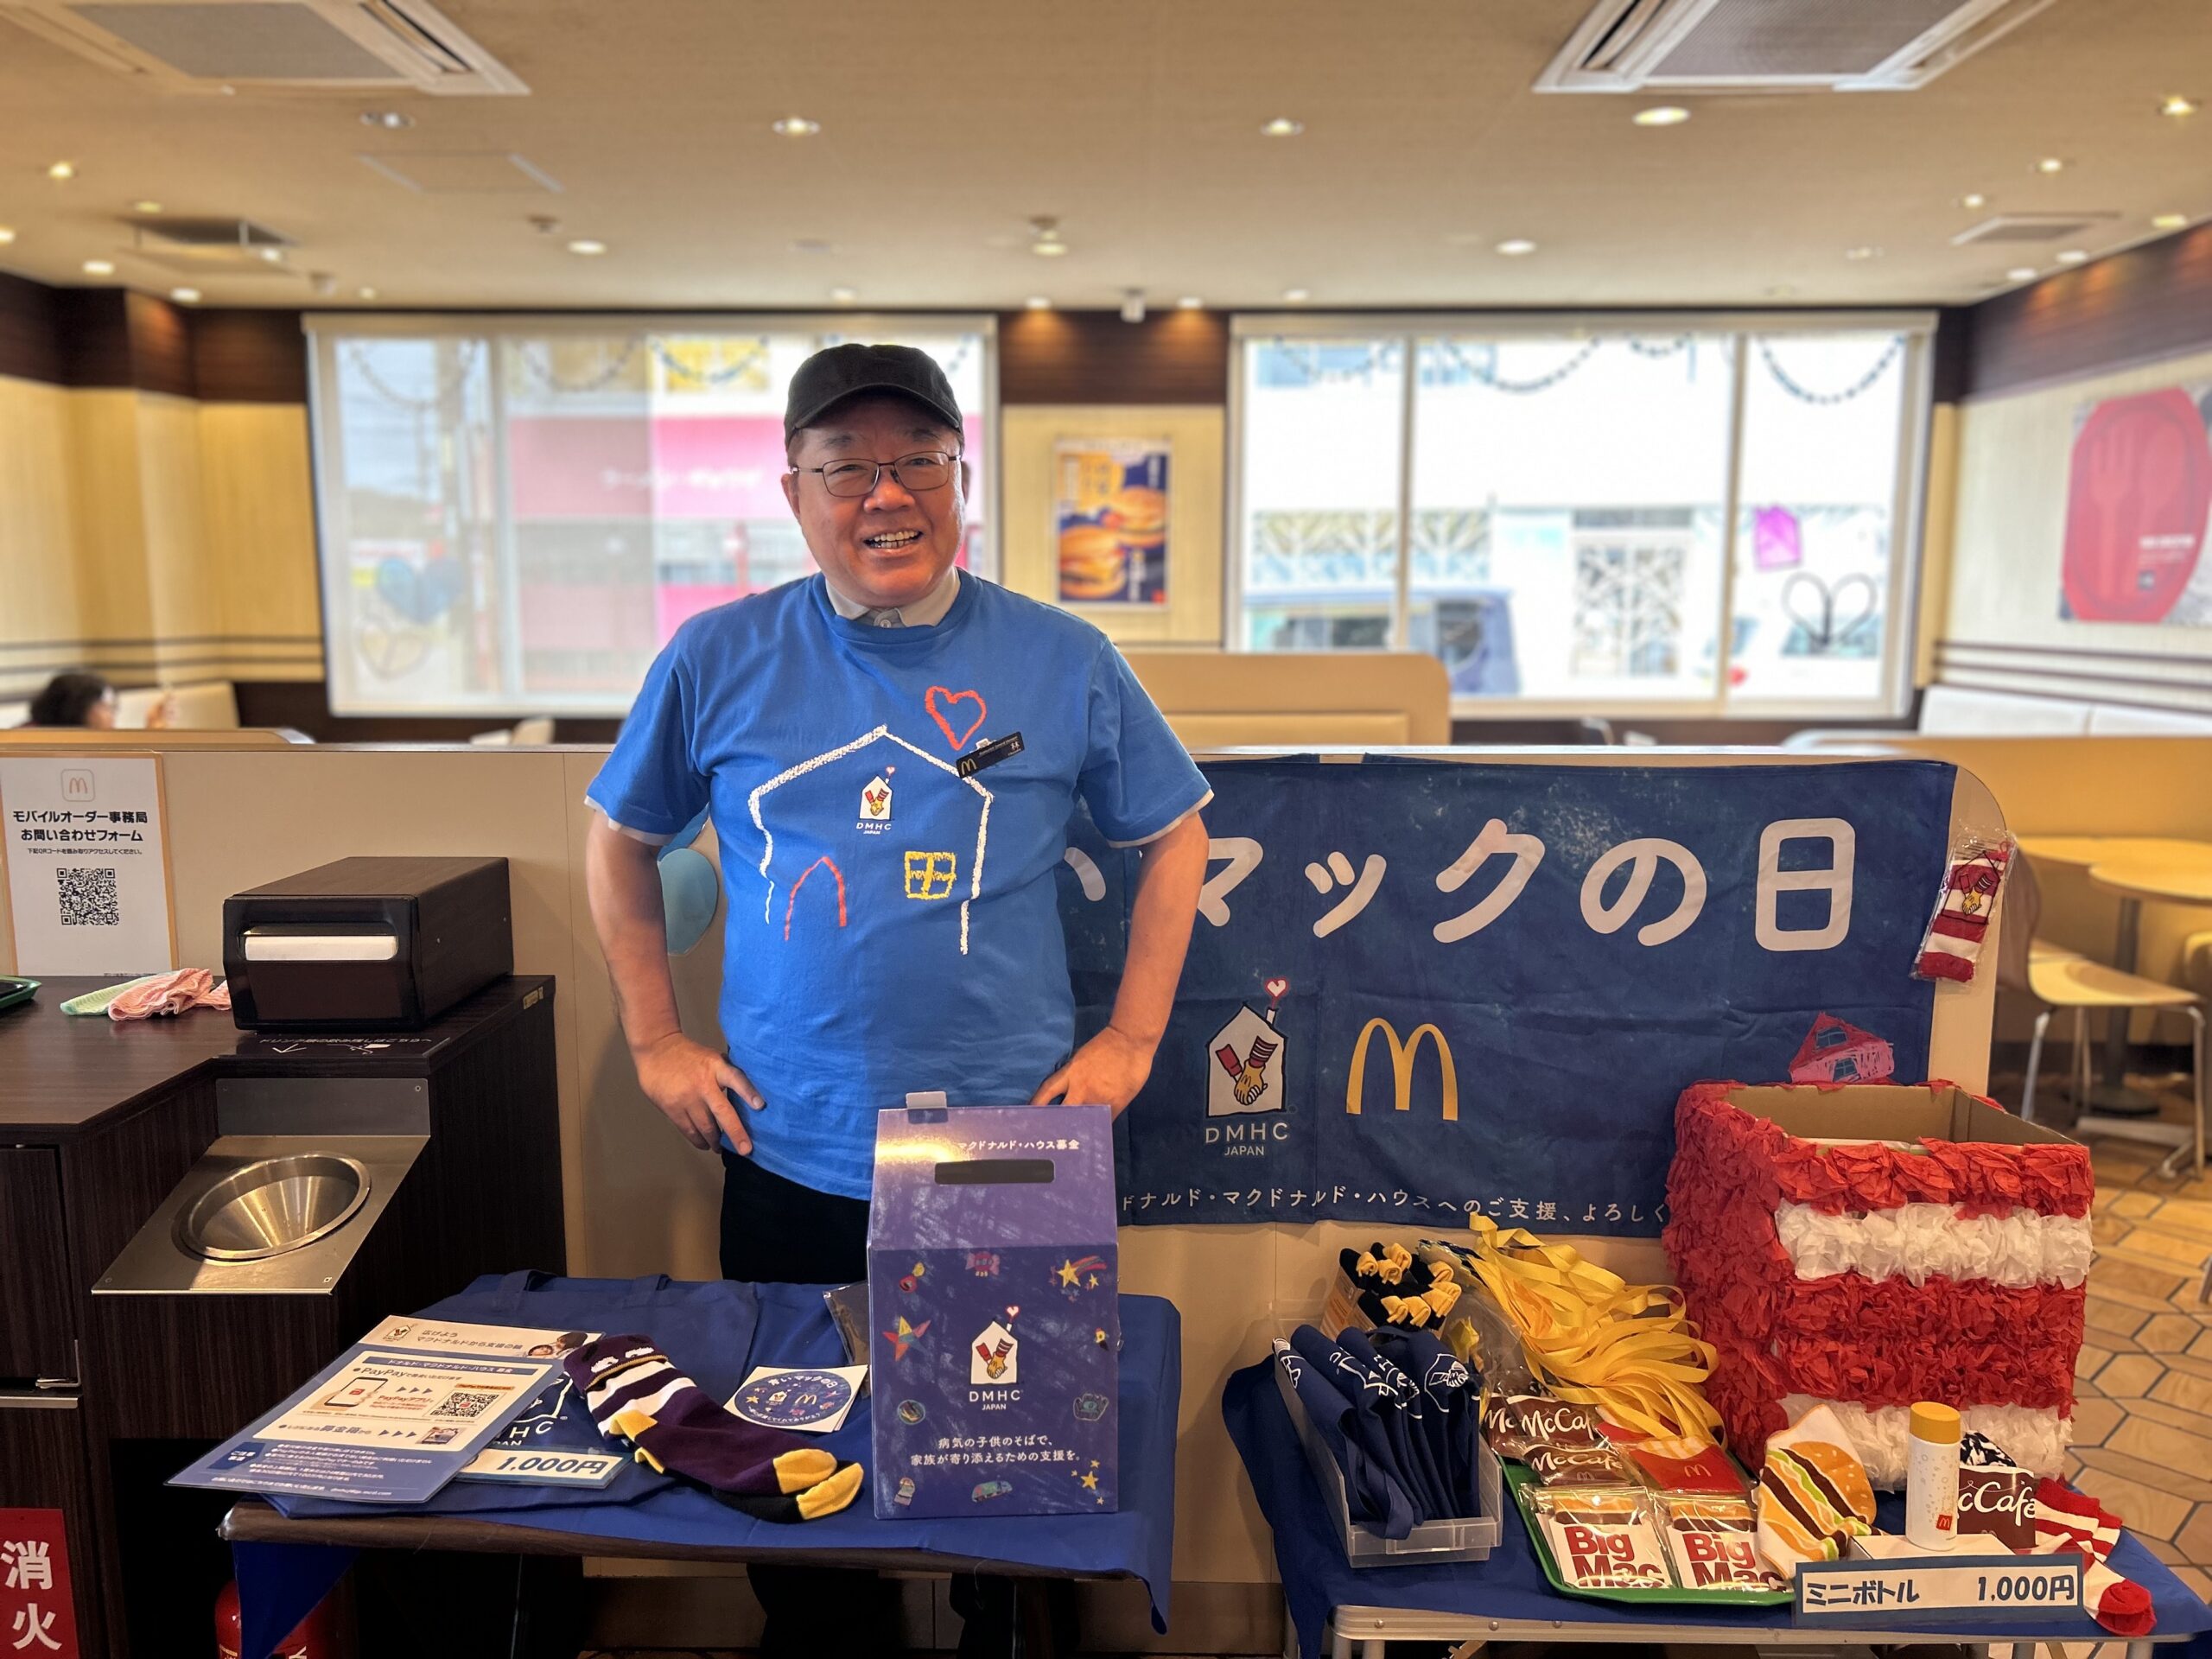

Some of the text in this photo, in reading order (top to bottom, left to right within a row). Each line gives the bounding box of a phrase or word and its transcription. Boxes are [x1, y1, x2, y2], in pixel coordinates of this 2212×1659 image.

[13, 810, 148, 823] モバイルオーダー事務局
[856, 822, 892, 830] DMHC
[21, 829, 143, 842] お問い合わせフォーム
[1205, 1122, 1288, 1143] DMHC
[1224, 1146, 1264, 1156] JAPAN
[969, 1389, 1021, 1402] DMHC
[938, 1434, 1052, 1449] 病気の子供のそばで、
[497, 1456, 608, 1474] 1,000円
[911, 1450, 1080, 1466] 家族が寄り添えるための支援を。
[1957, 1481, 2035, 1527] cCafé
[1564, 1525, 1635, 1562] Big
[1682, 1532, 1756, 1569] Big
[1572, 1554, 1664, 1587] Mac
[1691, 1562, 1786, 1592] Mac
[0, 1540, 62, 1650] 消火
[1806, 1574, 2074, 1605] ミニボトル 1,000円
